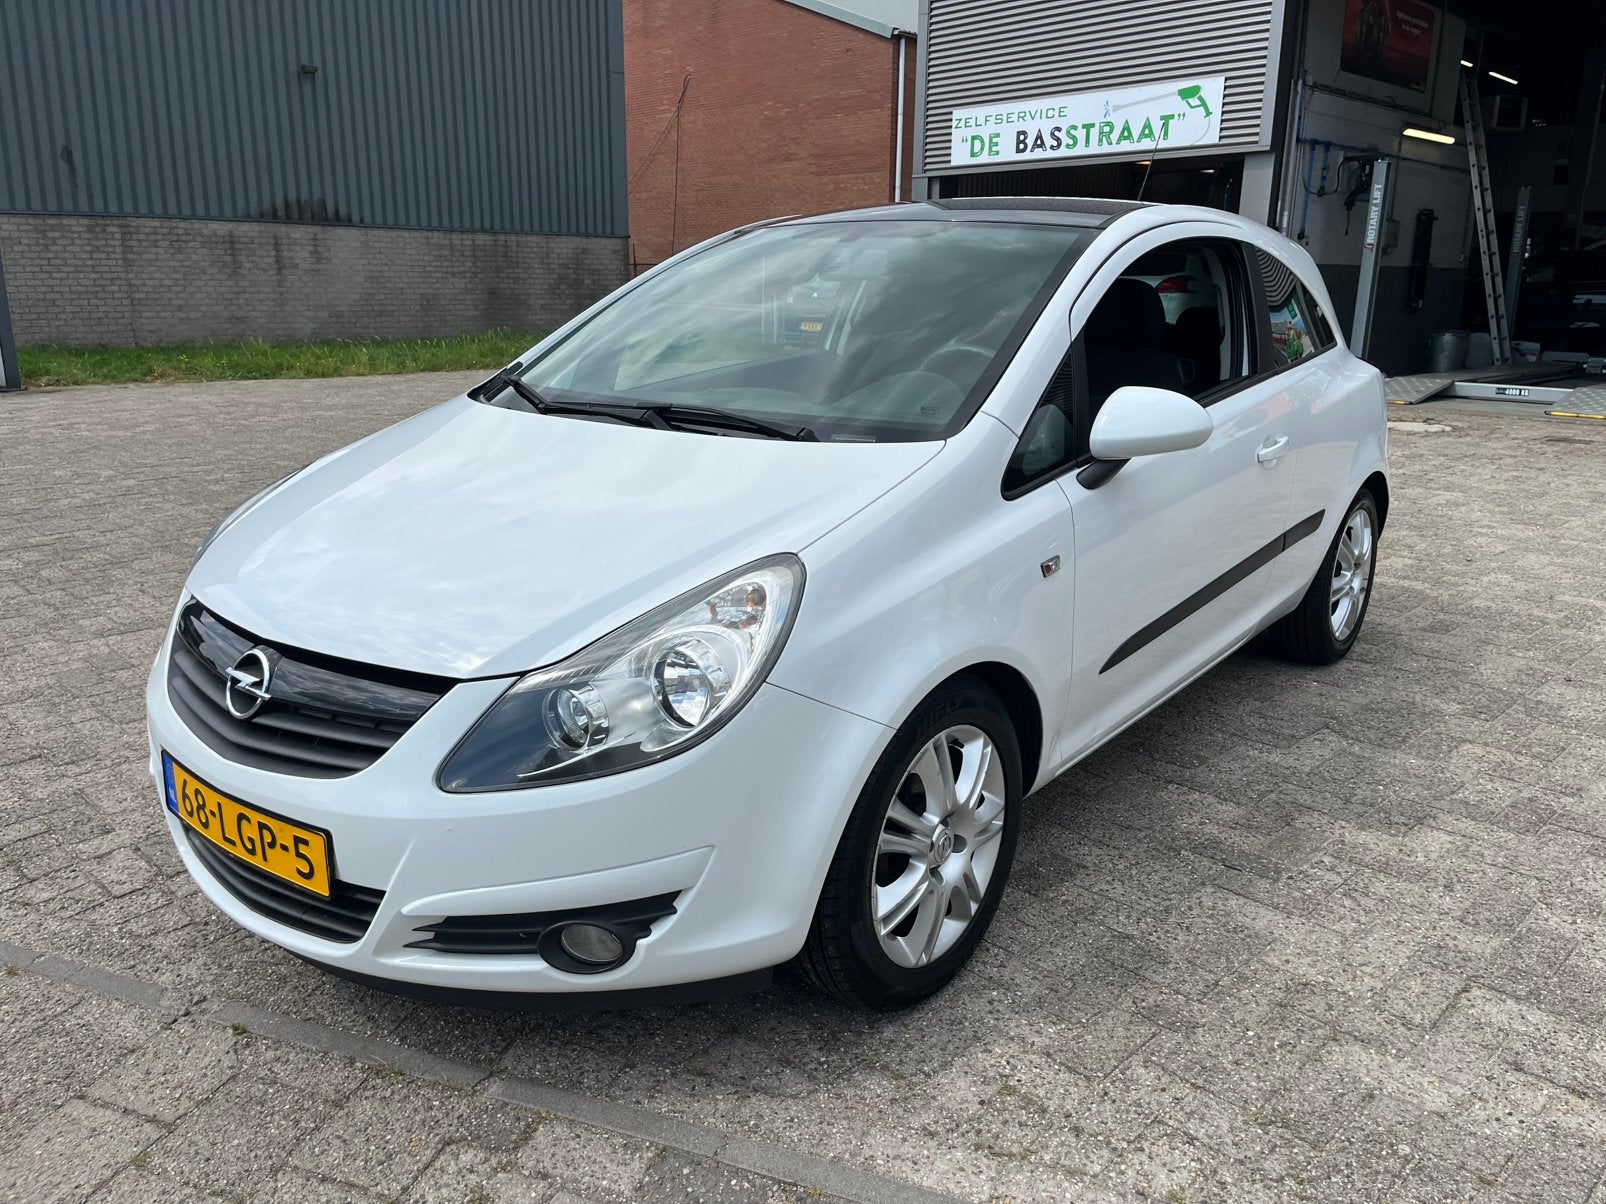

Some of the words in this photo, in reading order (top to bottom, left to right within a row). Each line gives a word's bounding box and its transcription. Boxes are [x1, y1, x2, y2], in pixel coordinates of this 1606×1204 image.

[954, 106, 1068, 129] ZELFSERVICE
[1372, 184, 1382, 204] LIFT
[1366, 206, 1379, 244] ROTARY
[1505, 388, 1520, 396] 4000
[181, 778, 315, 881] 68-LGP-5
